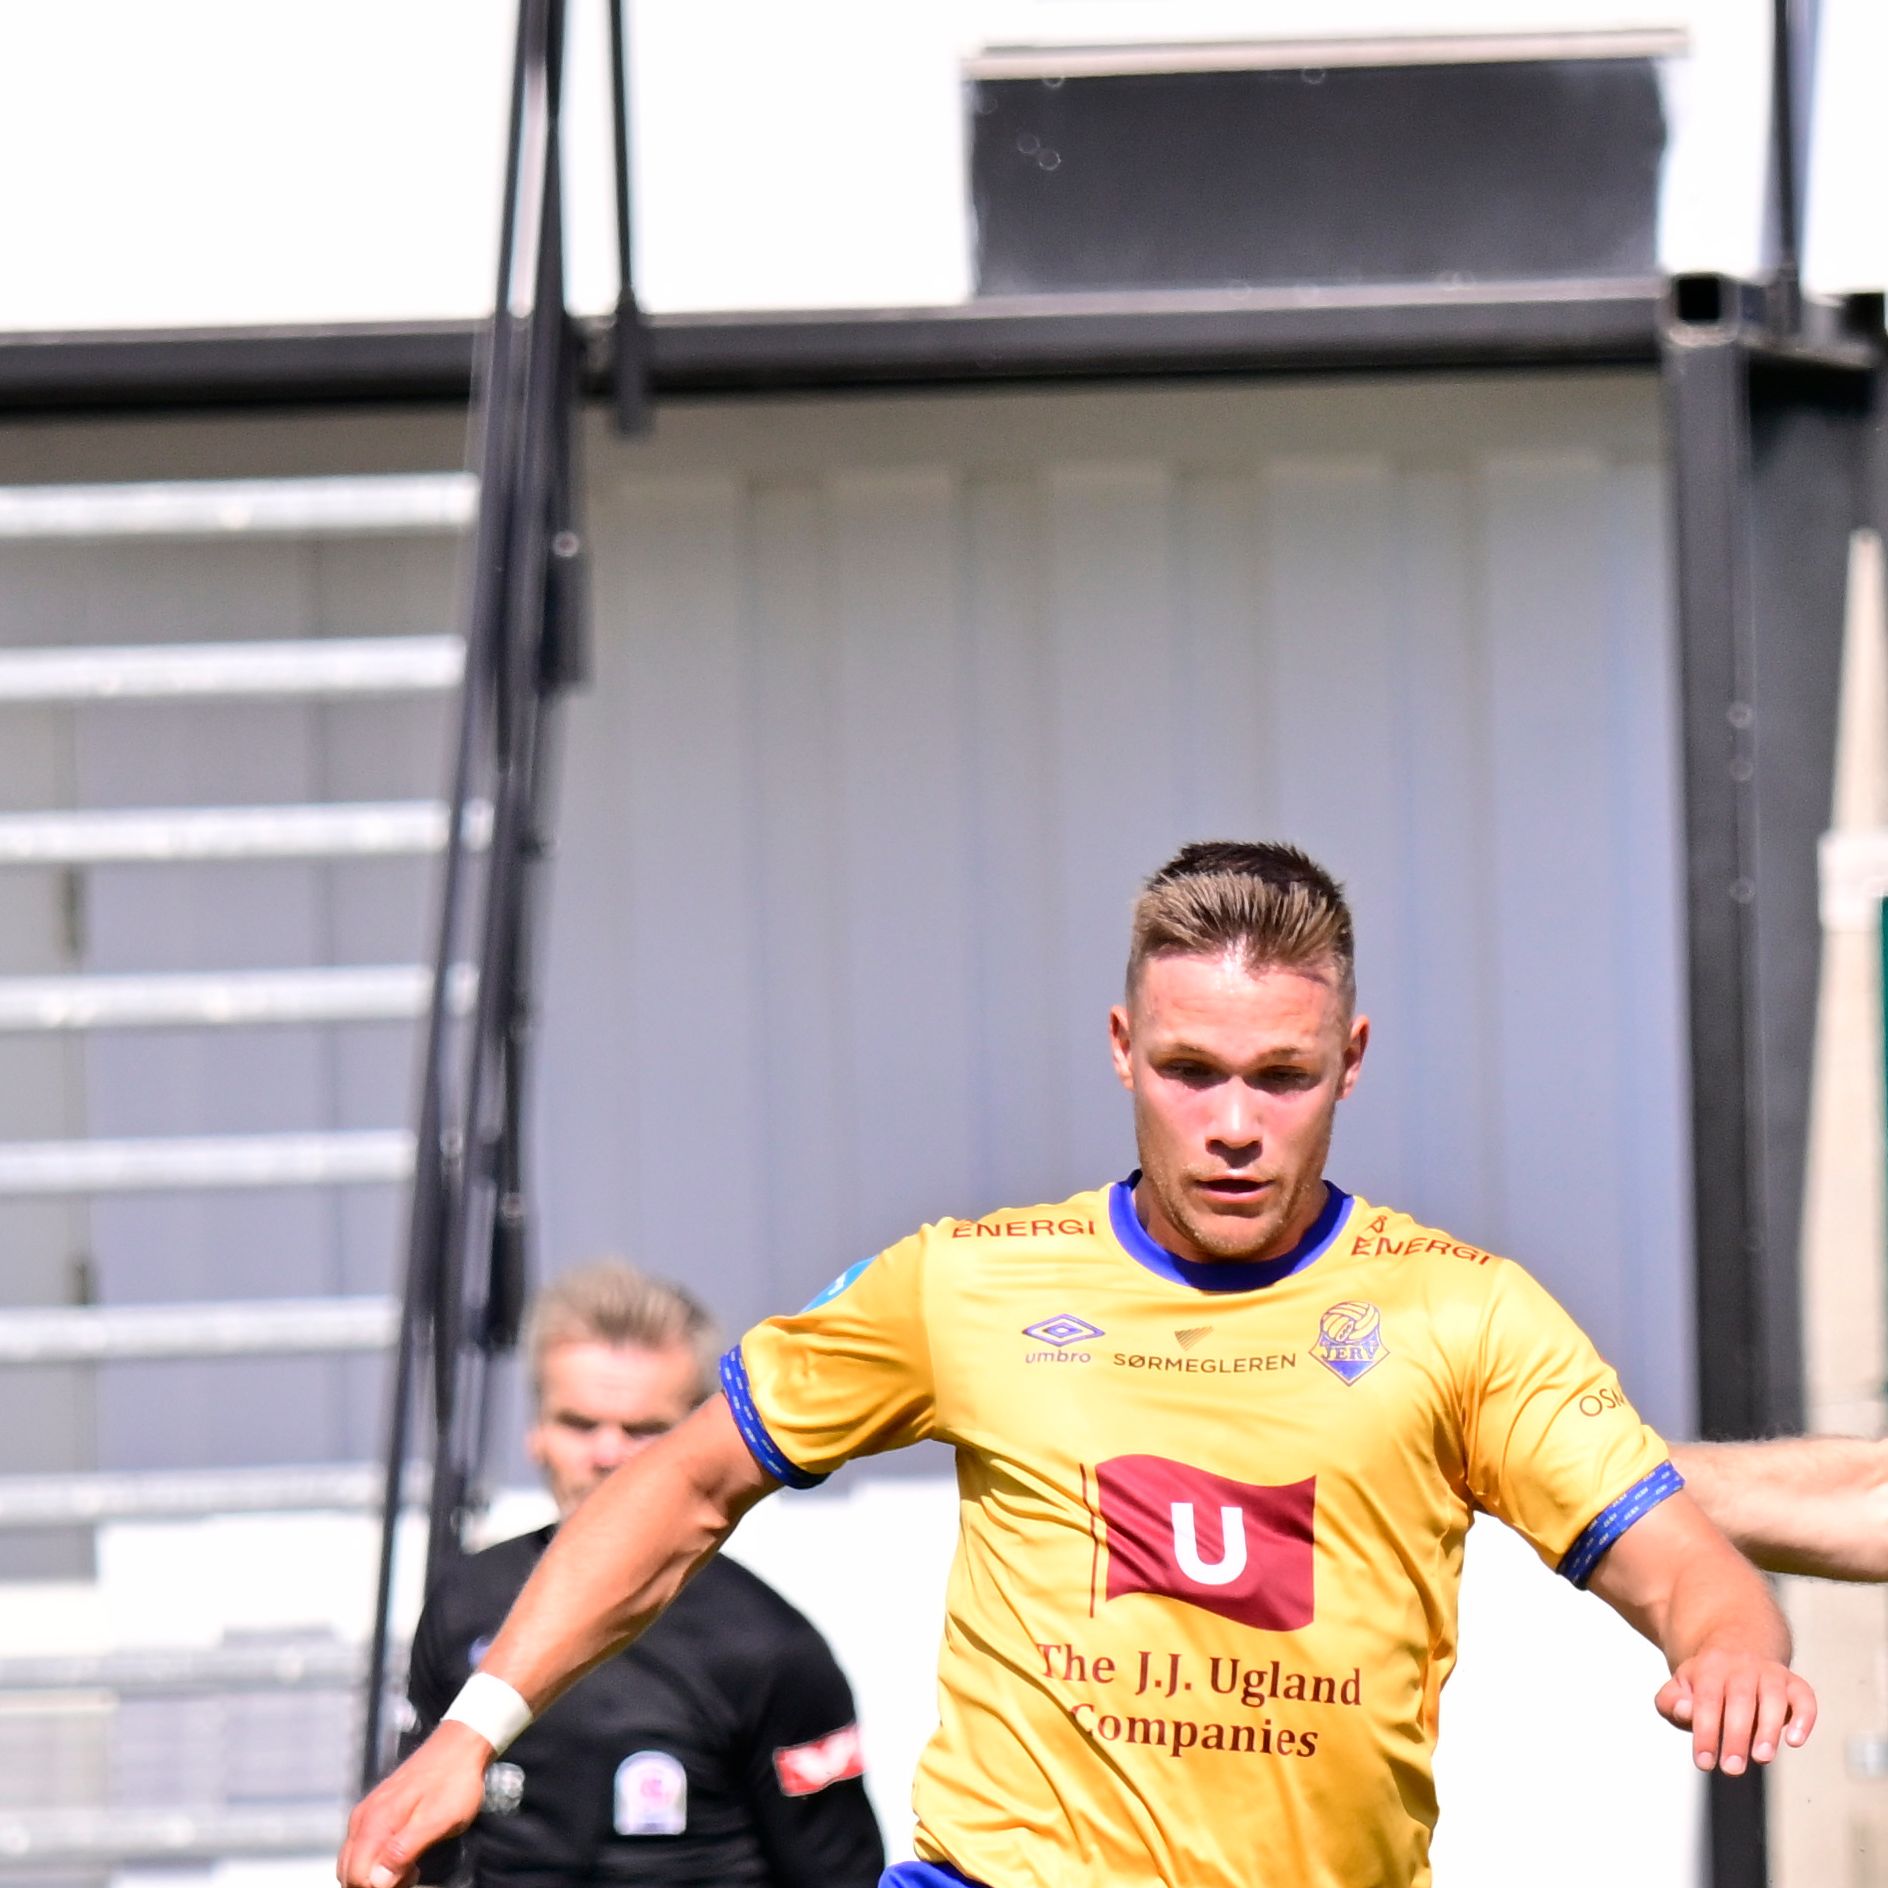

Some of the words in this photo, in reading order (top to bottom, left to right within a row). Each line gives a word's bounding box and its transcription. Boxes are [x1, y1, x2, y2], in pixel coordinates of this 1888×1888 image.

[951, 1218, 1096, 1239] ENERGI
[1350, 1236, 1491, 1267] ENERGI
[1024, 1350, 1091, 1364] umbro
[1112, 1350, 1297, 1374] SØRMEGLEREN
[1321, 1344, 1378, 1362] JERV
[1170, 1502, 1248, 1586] U
[1035, 1642, 1117, 1684] The
[1134, 1650, 1193, 1699] J.J.
[1209, 1656, 1362, 1709] Ugland
[1068, 1703, 1319, 1758] Companies
